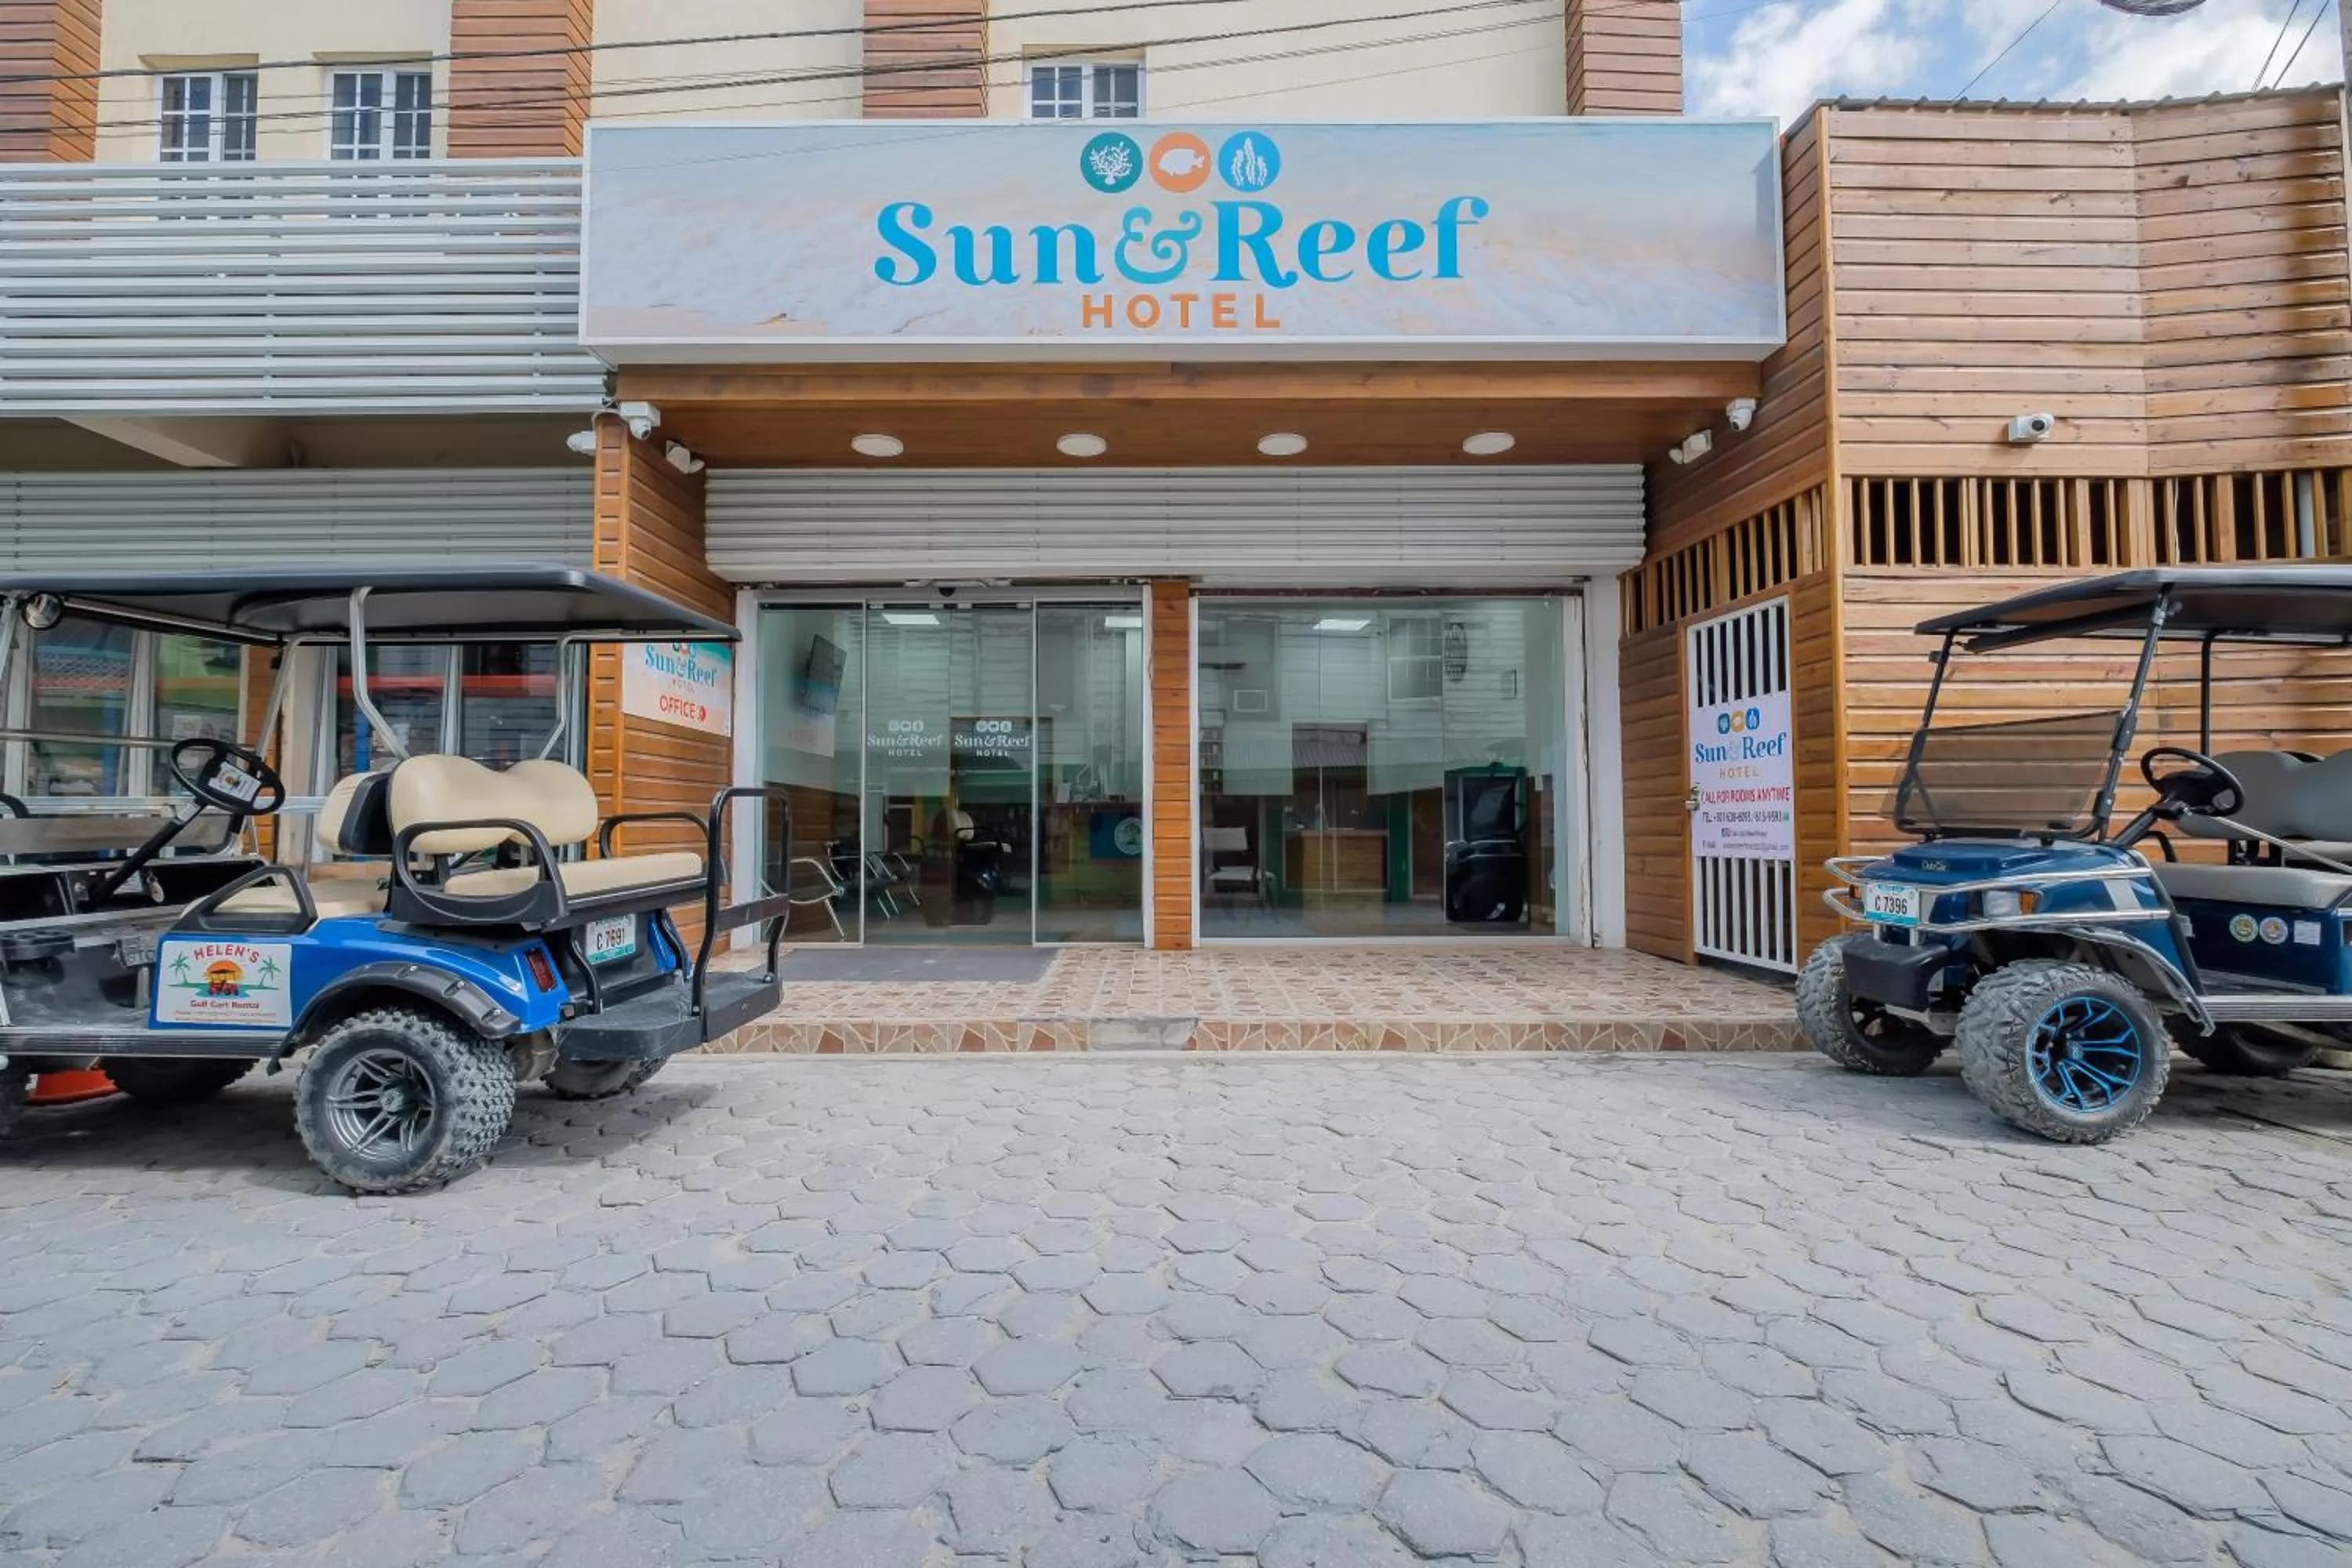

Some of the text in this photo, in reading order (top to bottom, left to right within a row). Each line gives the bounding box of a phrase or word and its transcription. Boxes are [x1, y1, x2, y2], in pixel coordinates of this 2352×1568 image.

[1082, 293, 1280, 328] HOTEL
[659, 695, 695, 719] OFFICE
[887, 749, 924, 757] HOTEL
[976, 749, 1011, 757] HOTEL
[1719, 766, 1760, 779] HOTEL
[1701, 786, 1790, 804] CALL FOR ROOMS ANYTIME
[1875, 895, 1907, 915] C 7396
[597, 932, 603, 950] C
[194, 944, 260, 963] HELEN'S
[191, 1000, 260, 1010] Golf Cart Rental
